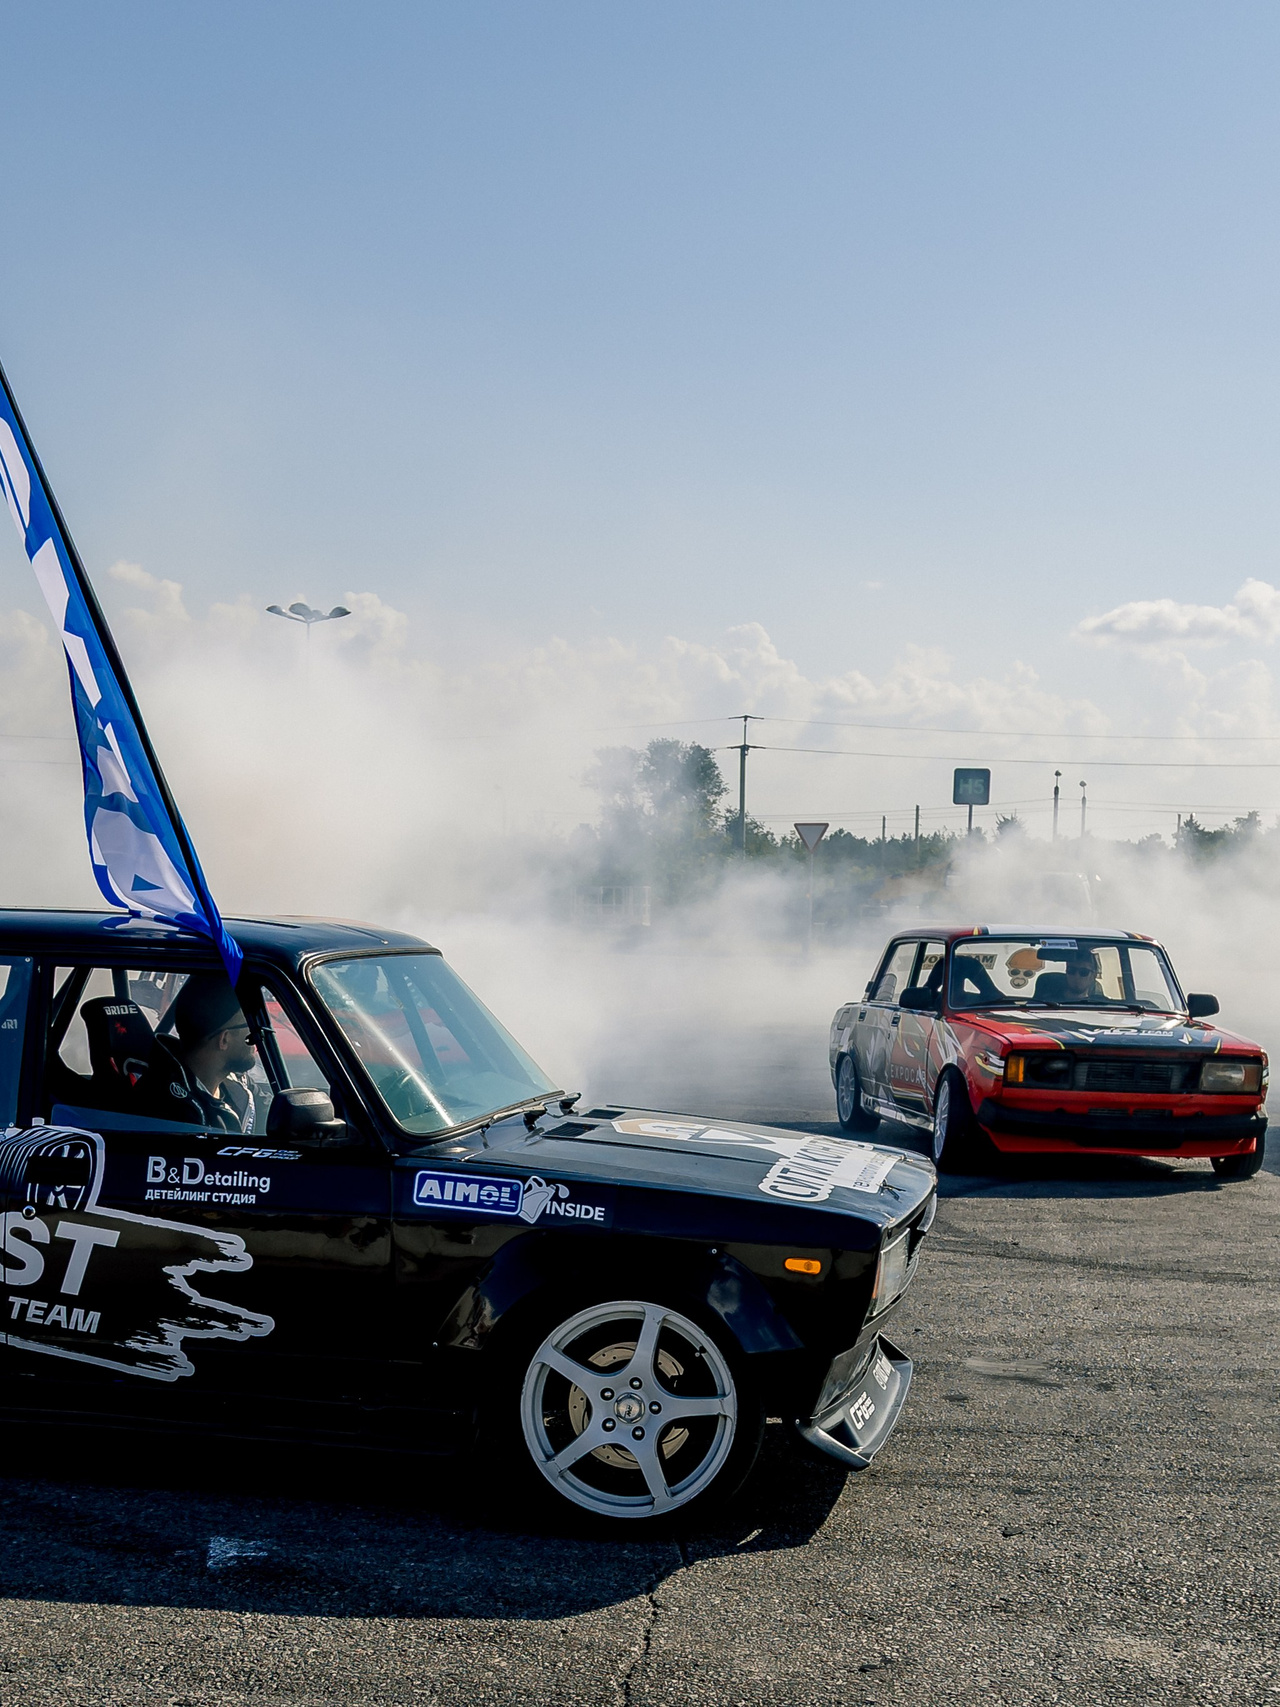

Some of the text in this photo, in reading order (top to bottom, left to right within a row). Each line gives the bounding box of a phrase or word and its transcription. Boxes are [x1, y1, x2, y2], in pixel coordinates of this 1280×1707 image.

[103, 1004, 138, 1015] BRIDE
[217, 1146, 277, 1157] CFG
[146, 1156, 271, 1193] B&Detailing
[145, 1187, 257, 1205] ДЕТЕЙЛИНГ СТУДИЯ
[545, 1200, 606, 1221] INSIDE
[8, 1296, 101, 1334] TEAM
